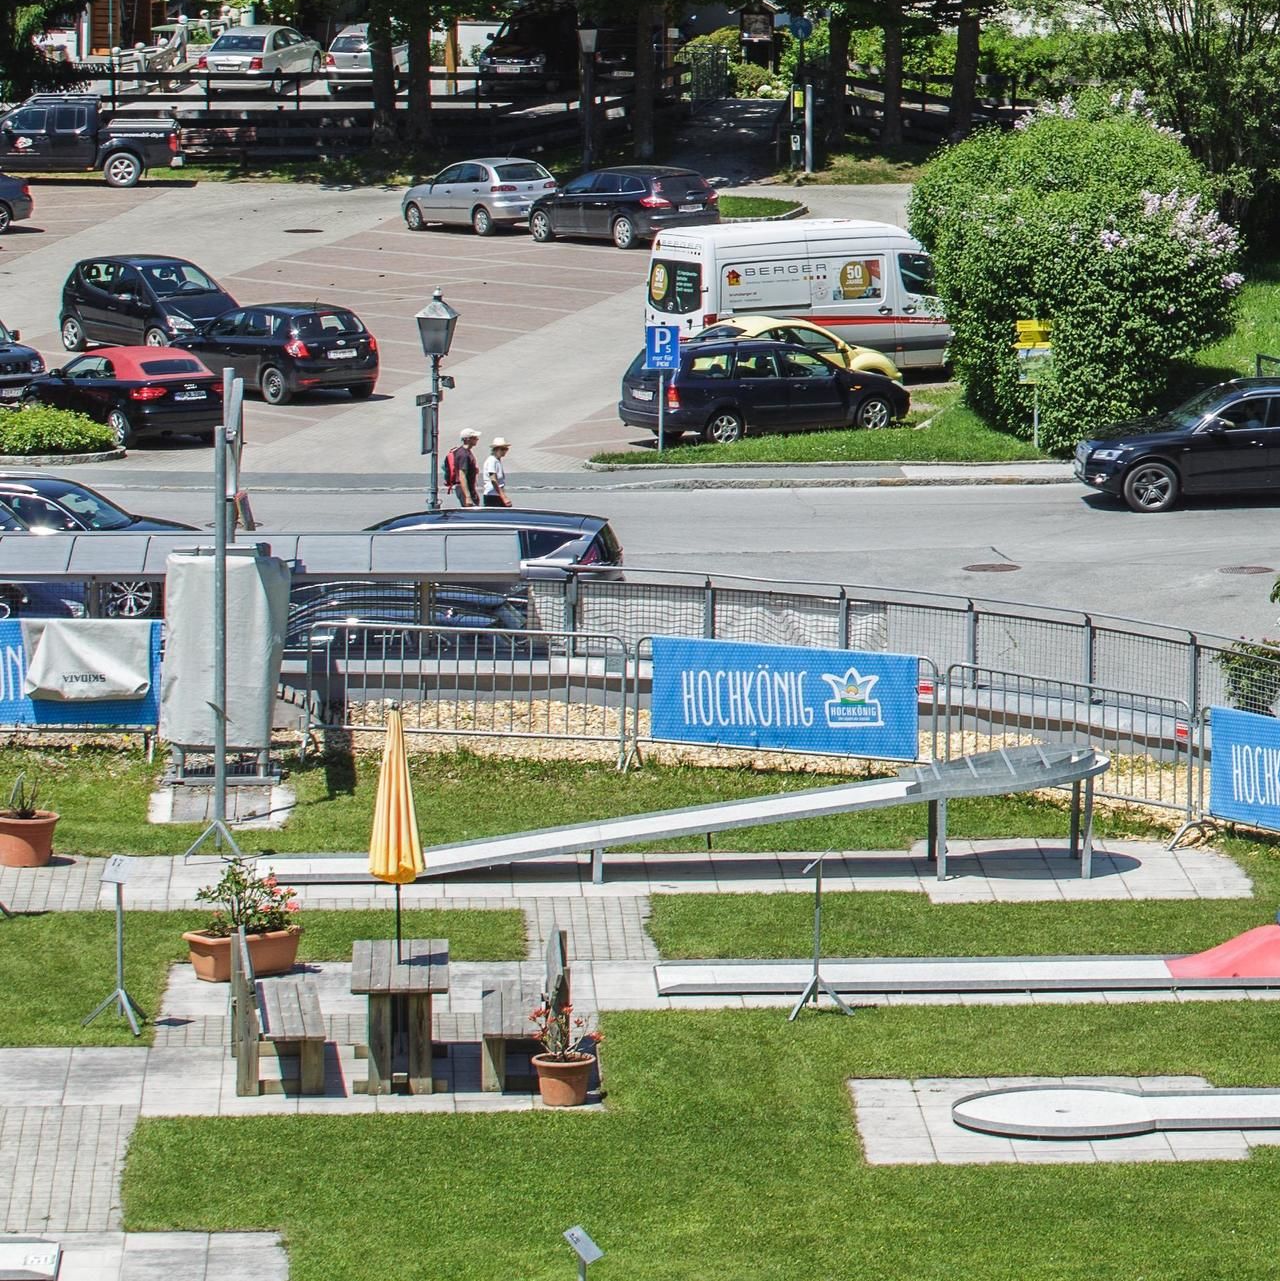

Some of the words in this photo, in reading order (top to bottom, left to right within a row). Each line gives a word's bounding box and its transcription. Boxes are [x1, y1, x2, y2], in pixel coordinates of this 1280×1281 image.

[655, 268, 665, 282] 50
[744, 263, 827, 277] BERGER
[846, 265, 863, 279] 50
[655, 327, 672, 353] P
[61, 673, 107, 683] SKIDATA
[682, 664, 814, 728] HOCHKÖNIG
[830, 704, 877, 717] HOCHKÖNIG
